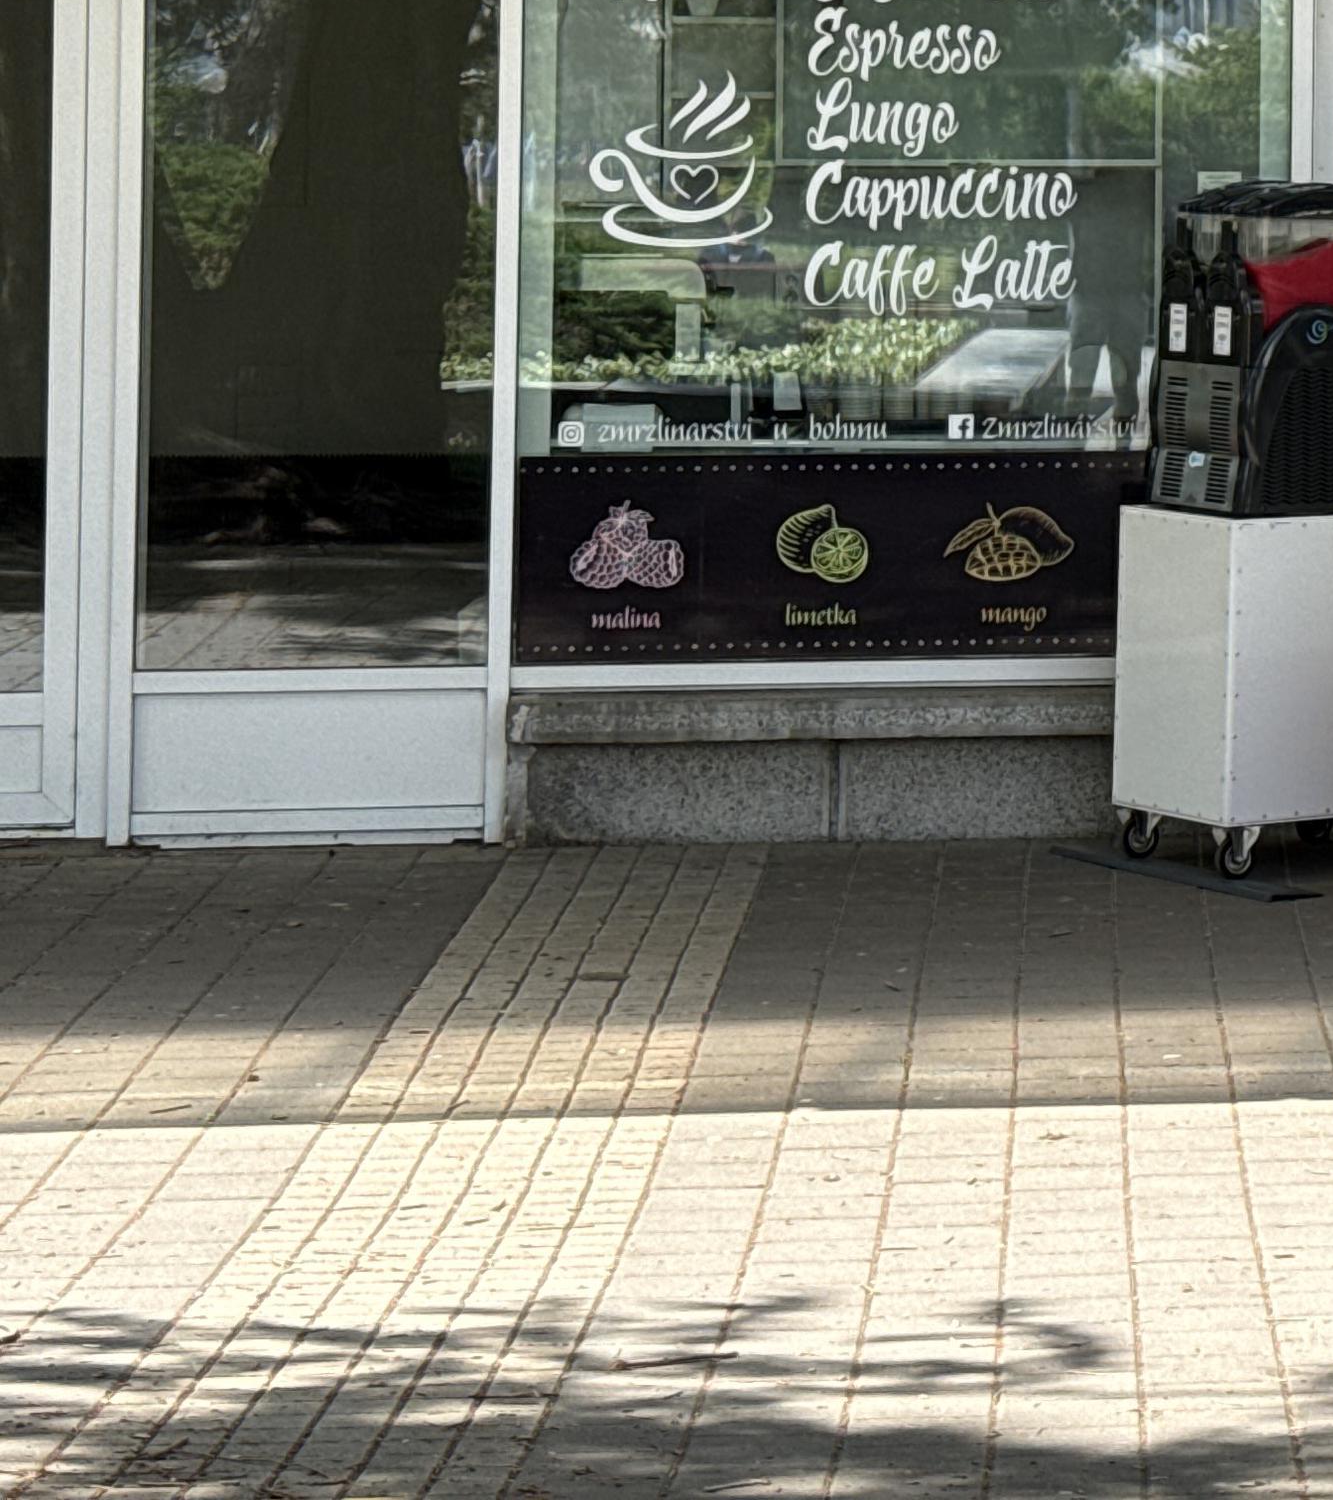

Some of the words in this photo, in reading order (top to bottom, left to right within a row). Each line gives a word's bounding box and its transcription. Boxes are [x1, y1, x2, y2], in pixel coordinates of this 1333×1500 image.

[807, 6, 1001, 80] Espresso
[807, 78, 959, 157] Lungo
[805, 160, 1078, 231] Cappuccino
[804, 240, 940, 317] Caffe
[953, 235, 1078, 311] Latte
[590, 607, 662, 630] malina
[785, 602, 857, 627] limetka
[979, 604, 1048, 631] mango
